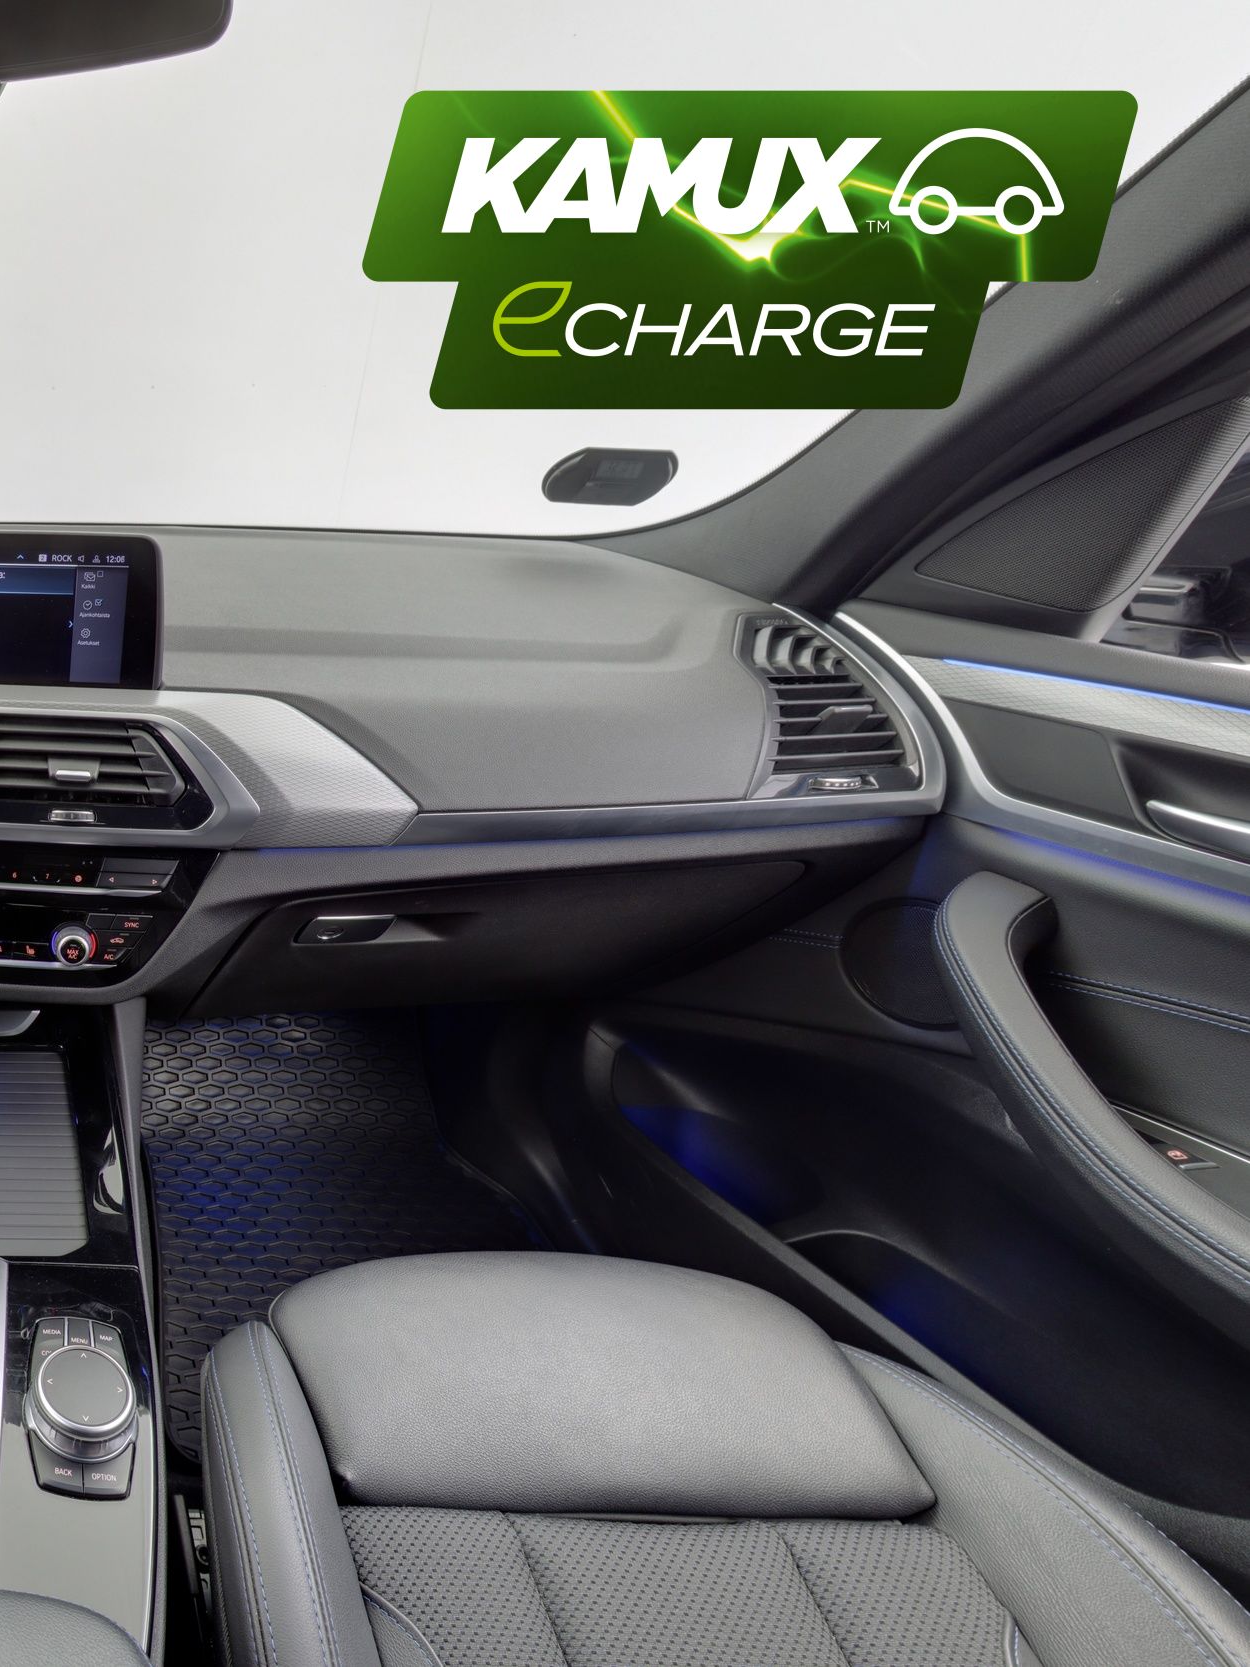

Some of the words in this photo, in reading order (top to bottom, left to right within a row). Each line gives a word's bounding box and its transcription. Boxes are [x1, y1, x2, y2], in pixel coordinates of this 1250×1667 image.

[51, 554, 73, 562] ROCK
[124, 921, 140, 929] SYNC
[103, 953, 114, 961] A/C
[70, 1337, 89, 1345] MENU
[99, 1334, 113, 1342] MAP
[54, 1467, 73, 1477] BACK
[91, 1472, 117, 1482] OPTION
